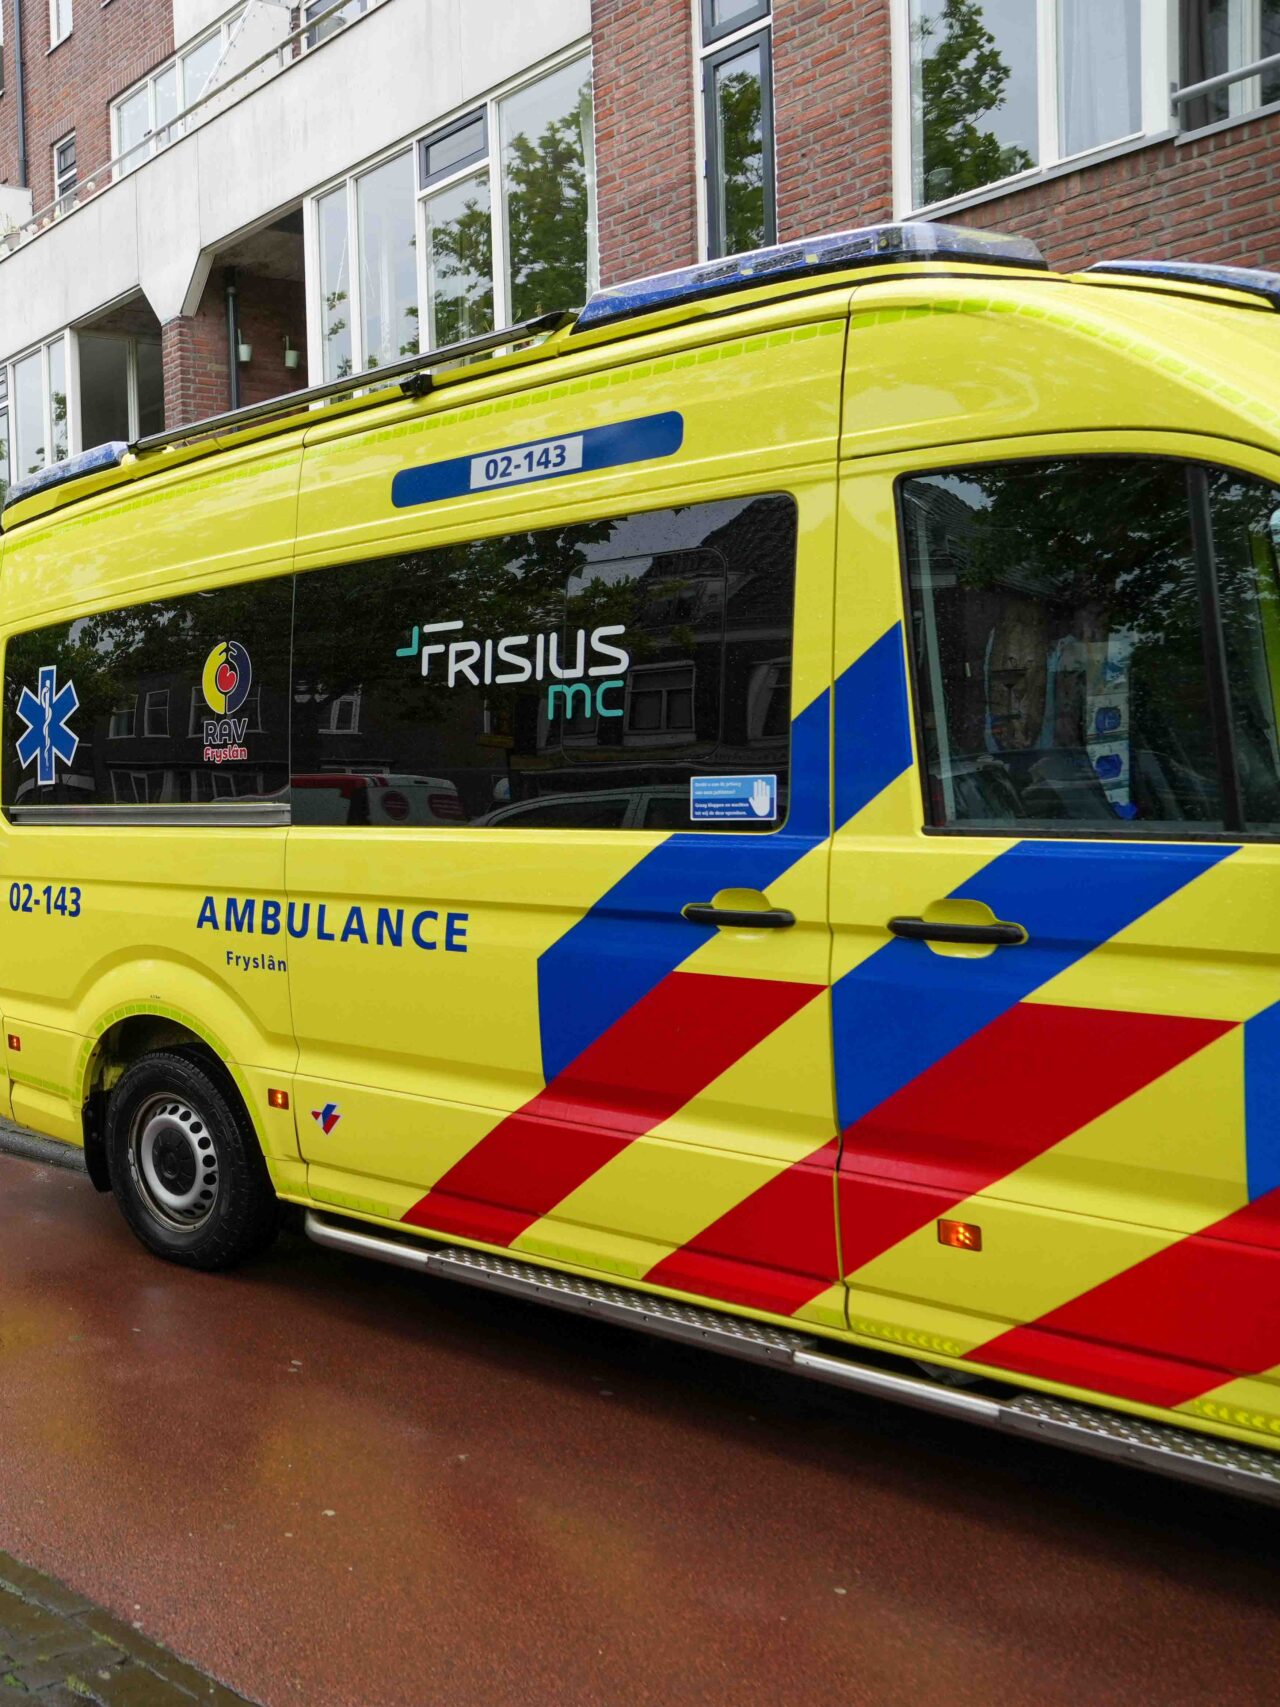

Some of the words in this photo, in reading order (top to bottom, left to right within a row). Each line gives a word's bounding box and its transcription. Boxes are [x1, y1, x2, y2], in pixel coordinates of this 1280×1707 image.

[485, 444, 566, 480] 02-143
[421, 620, 630, 688] FRISIUS
[203, 718, 248, 744] RAV
[9, 882, 81, 917] 02-143
[195, 896, 470, 952] AMBULANCE
[225, 950, 287, 972] Fryslân
